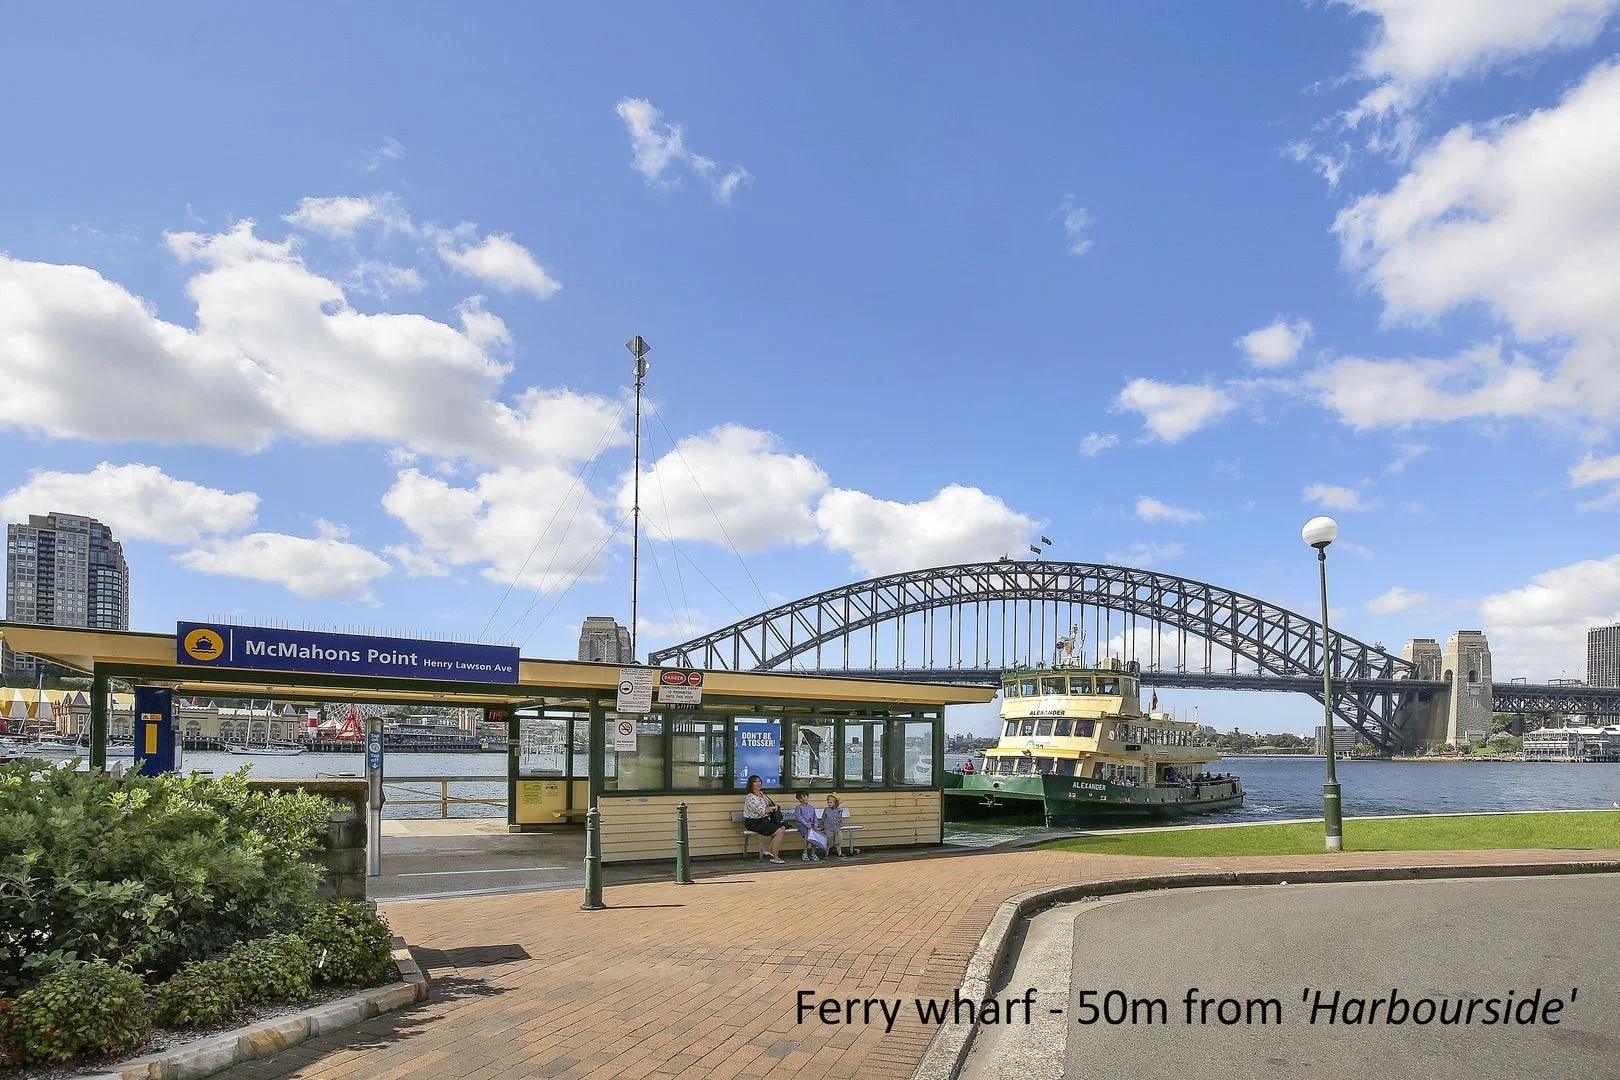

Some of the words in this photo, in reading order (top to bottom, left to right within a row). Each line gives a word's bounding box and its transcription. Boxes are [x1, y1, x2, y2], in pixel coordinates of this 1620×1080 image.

[245, 640, 361, 662] McMahons
[367, 649, 418, 666] Point
[424, 658, 453, 669] Henry
[455, 661, 492, 671] Lawson
[494, 664, 512, 673] Ave
[741, 732, 762, 740] DON'T
[1072, 782, 1106, 790] ALEXANDER
